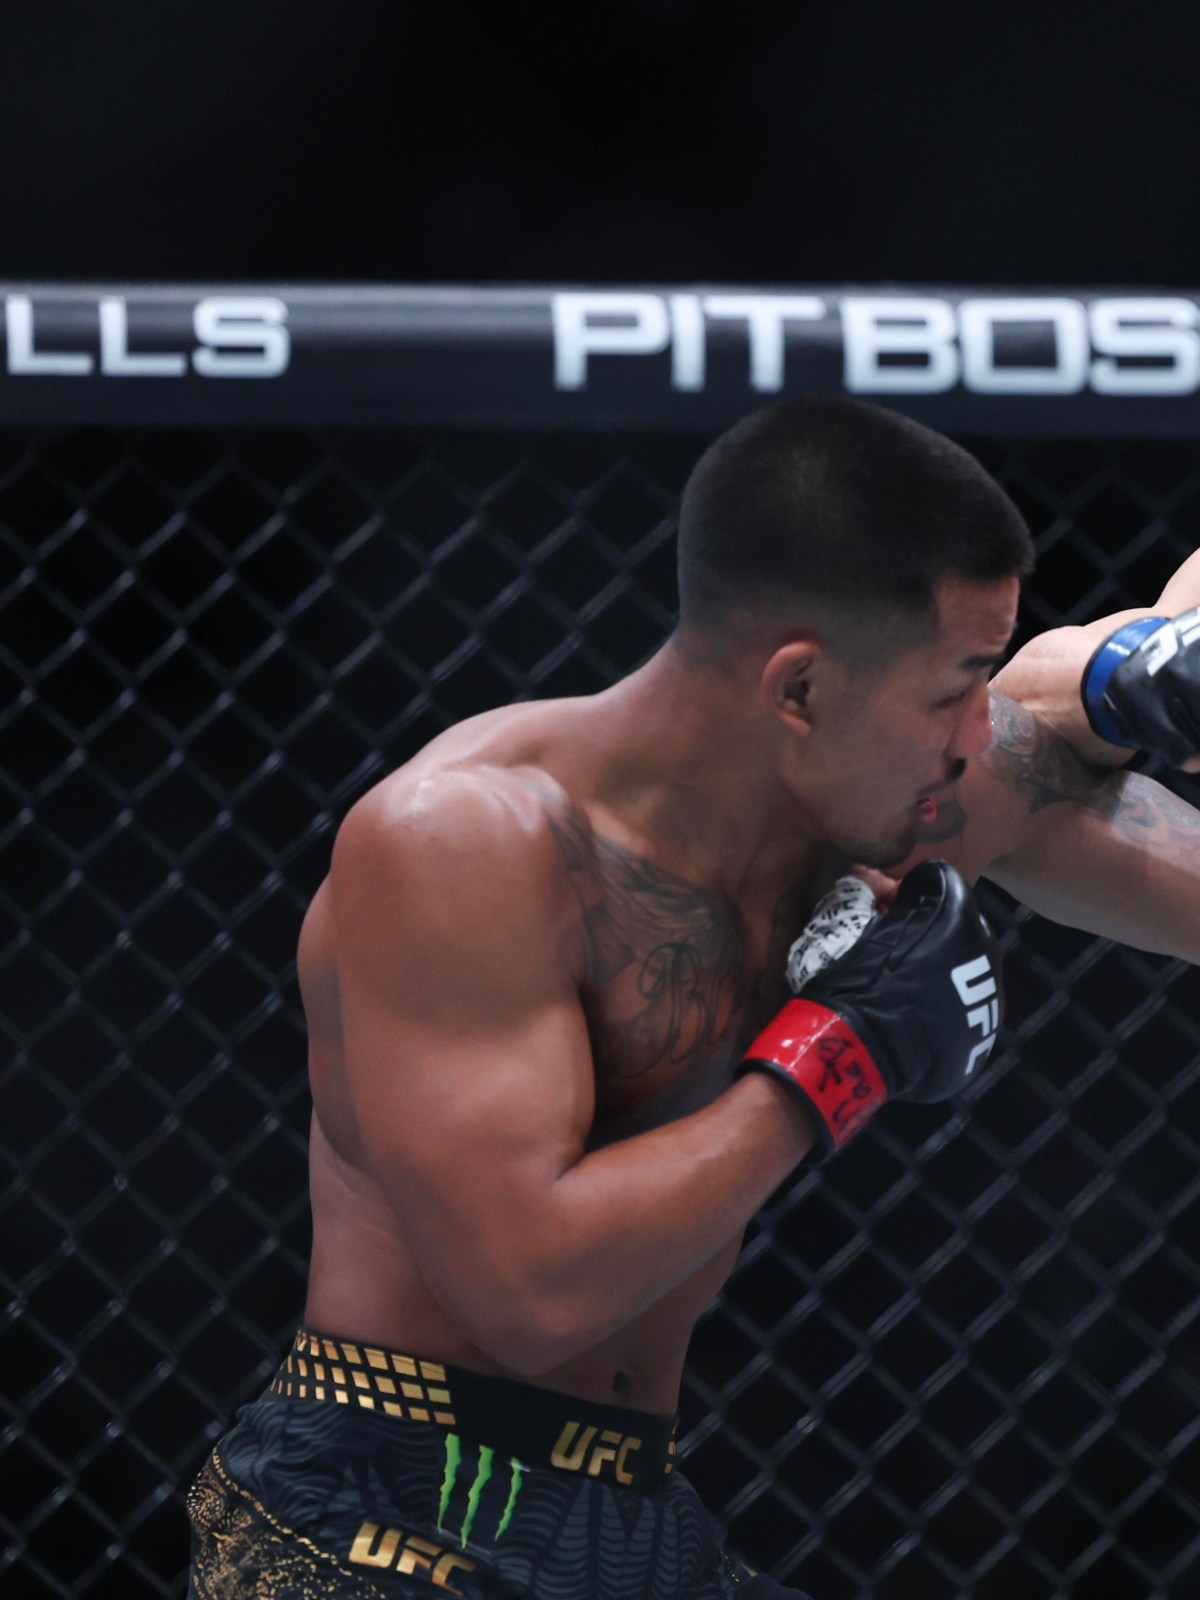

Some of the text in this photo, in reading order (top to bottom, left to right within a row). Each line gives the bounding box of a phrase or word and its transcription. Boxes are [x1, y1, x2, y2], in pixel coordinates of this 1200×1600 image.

[5, 294, 290, 379] LLS
[951, 955, 998, 1076] UFC
[551, 1420, 642, 1485] UFC
[349, 1521, 477, 1597] UFC
